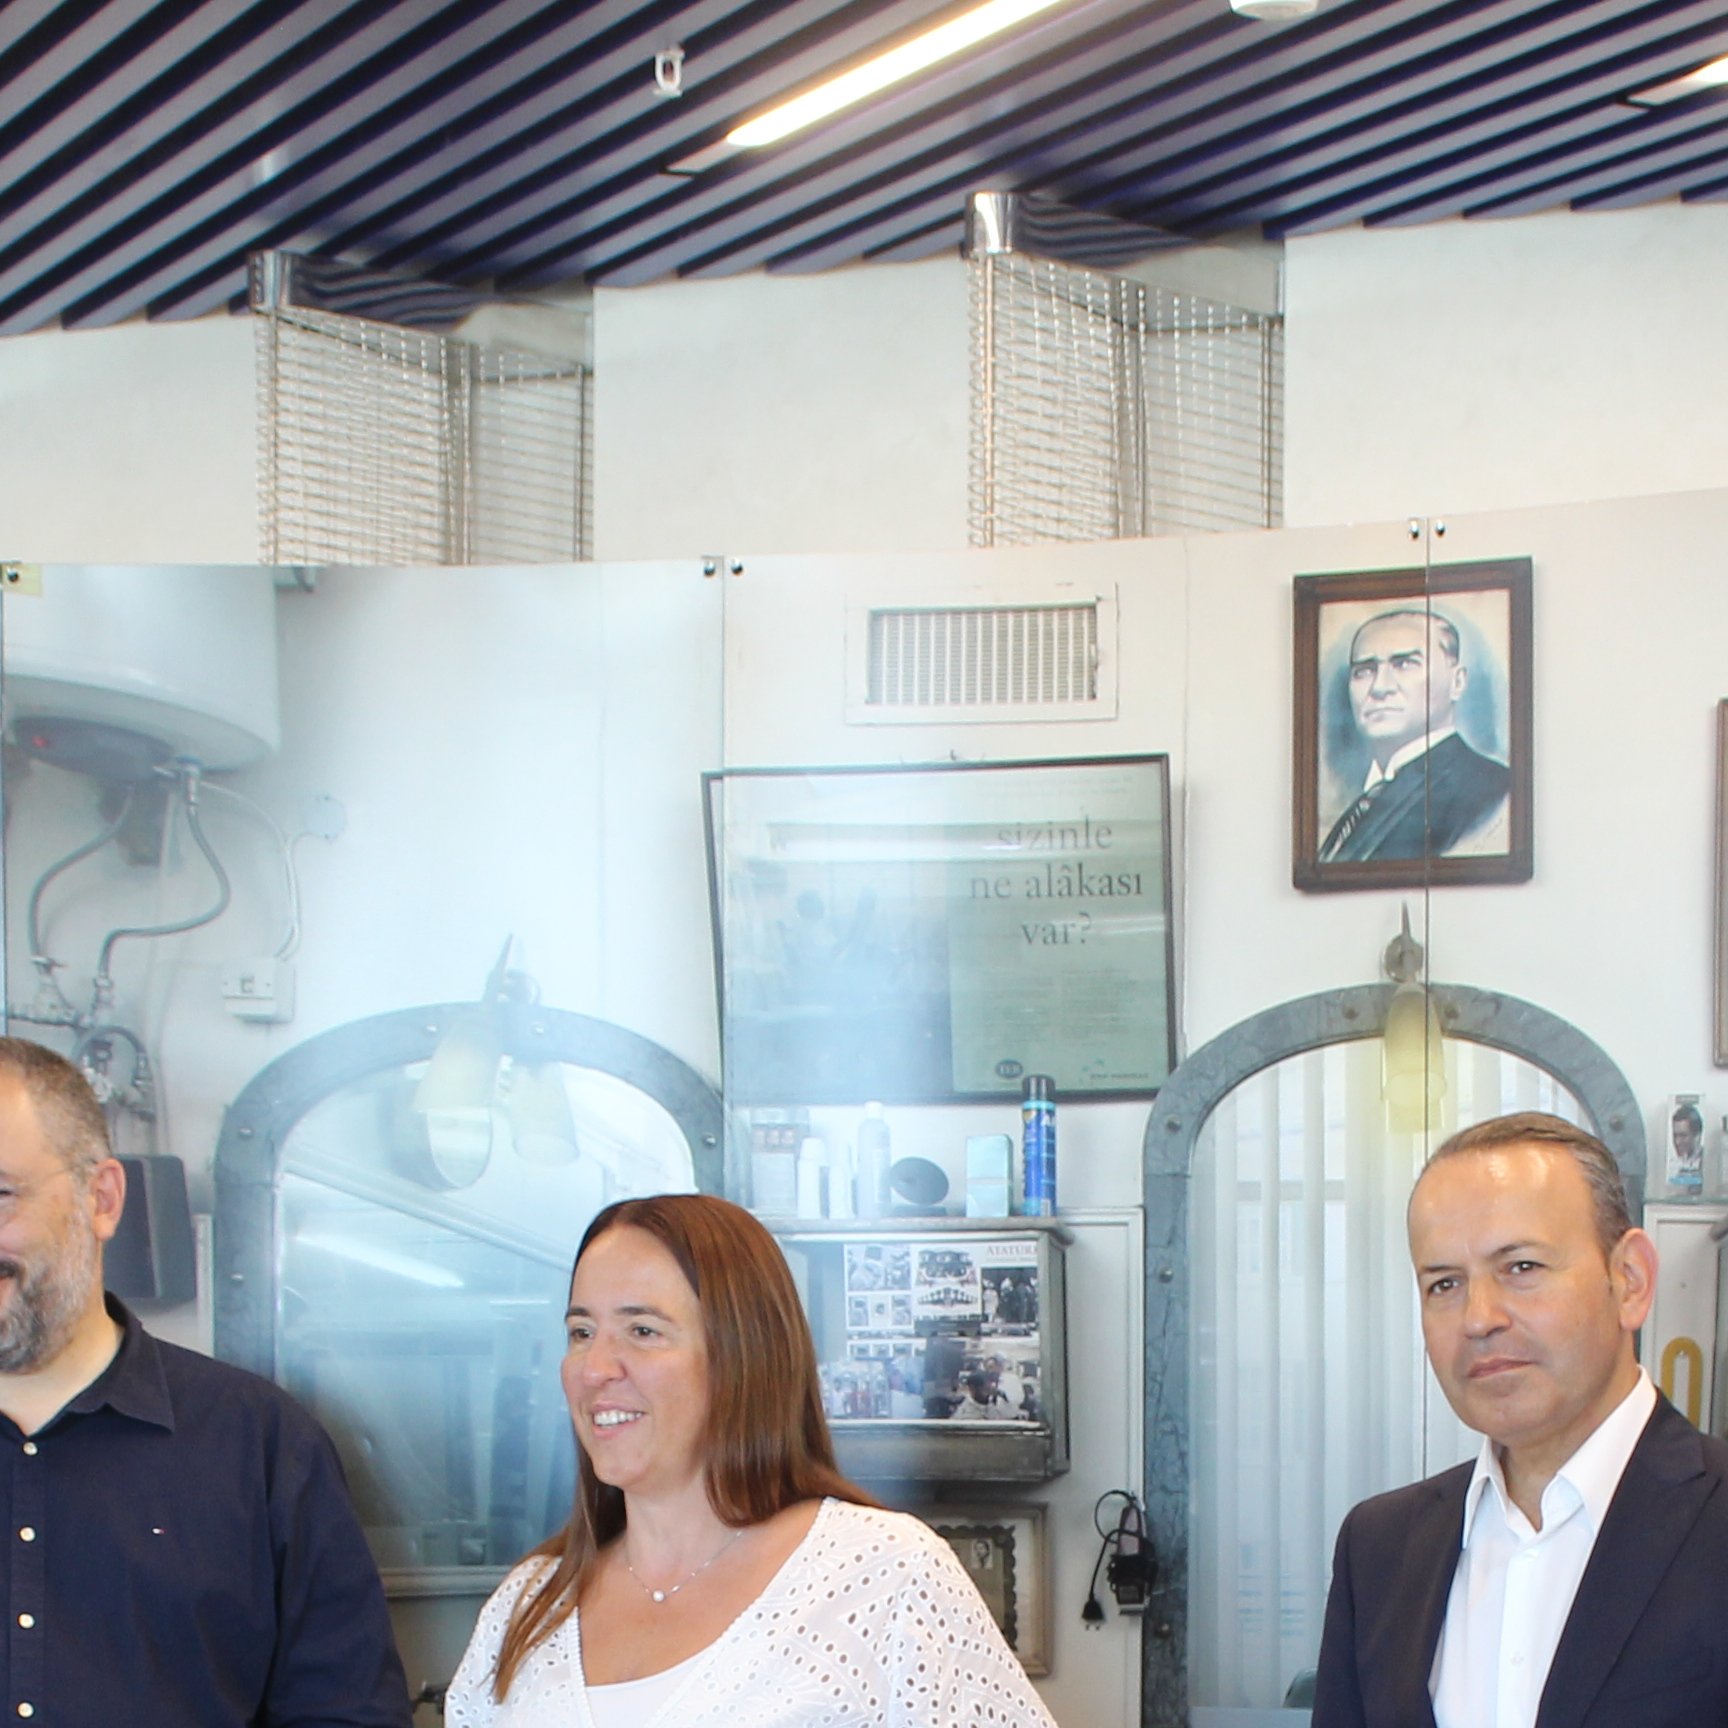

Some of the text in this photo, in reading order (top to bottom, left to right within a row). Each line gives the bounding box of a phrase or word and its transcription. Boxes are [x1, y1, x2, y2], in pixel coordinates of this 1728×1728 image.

[997, 814, 1113, 851] sizinle
[969, 861, 1144, 900] ne alâkası
[1021, 910, 1094, 946] var?
